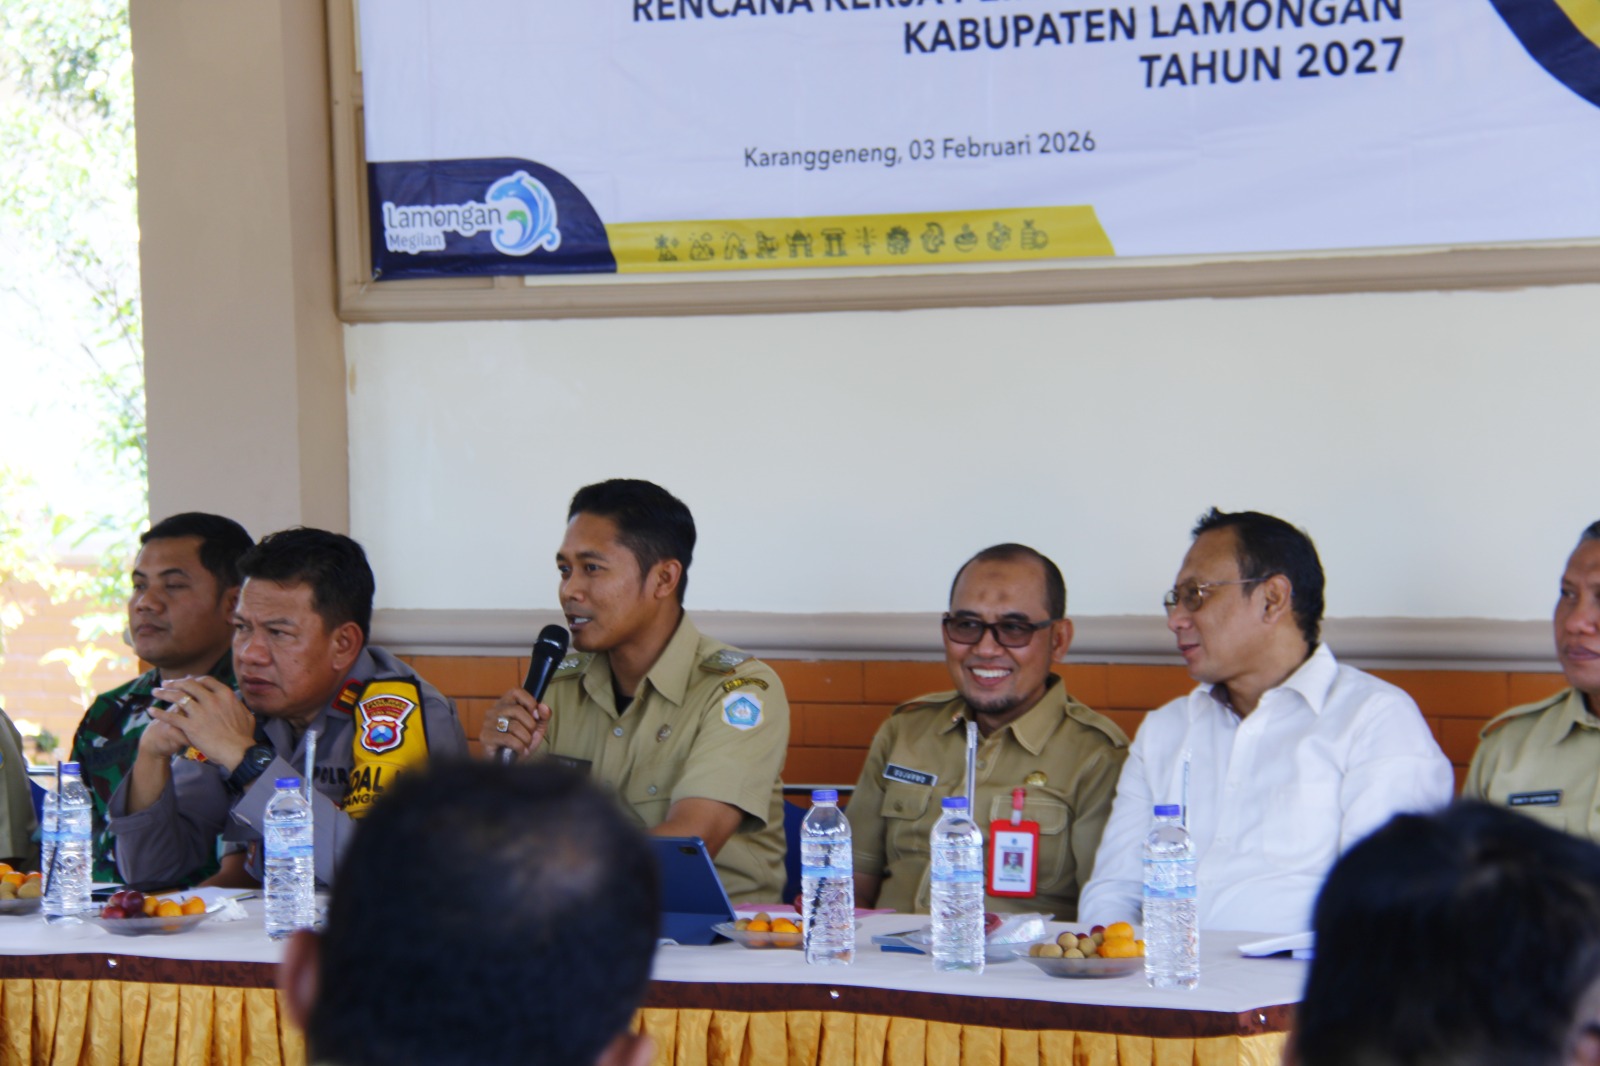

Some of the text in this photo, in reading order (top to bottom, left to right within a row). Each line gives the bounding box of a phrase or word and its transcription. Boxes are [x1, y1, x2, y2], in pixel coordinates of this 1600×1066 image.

[904, 0, 1402, 55] KABUPATEN LAMONGAN
[1138, 36, 1404, 89] TAHUN 2027
[743, 130, 1096, 171] Karanggeneng, 03 Februari 2026
[387, 205, 502, 231] Lamongan
[388, 232, 441, 250] Megilan
[314, 766, 350, 784] POLR
